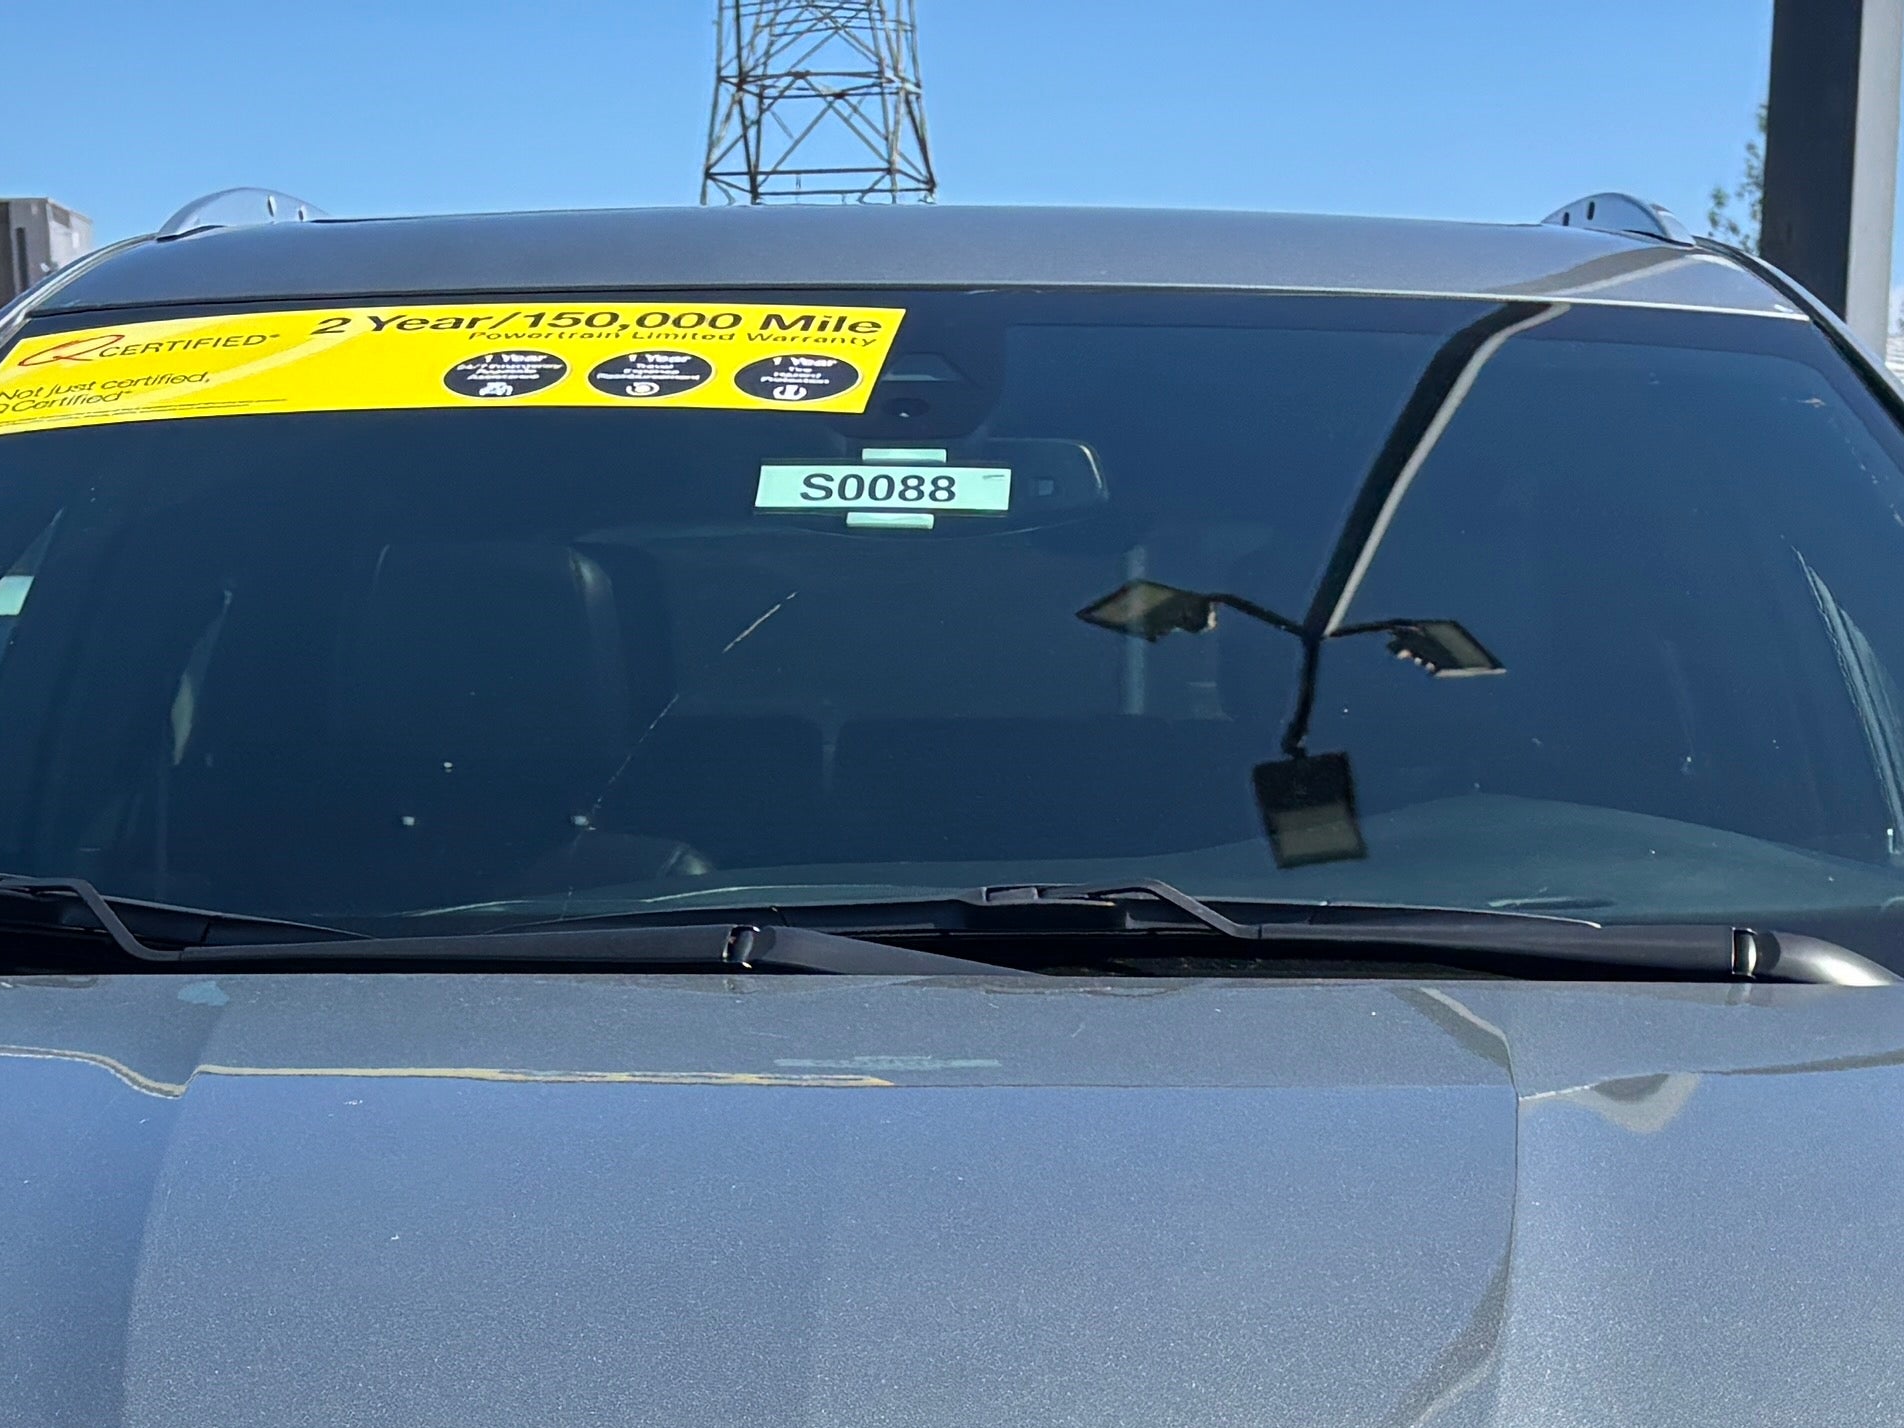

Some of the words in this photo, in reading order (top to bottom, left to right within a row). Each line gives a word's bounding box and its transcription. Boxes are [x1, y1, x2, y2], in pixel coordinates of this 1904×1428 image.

[310, 317, 352, 335] 2
[367, 311, 743, 332] Year/150,000
[759, 313, 883, 333] Mile
[632, 331, 736, 342] Limited
[746, 332, 878, 347] Warranty
[45, 380, 97, 399] just
[799, 472, 957, 503] S0088
